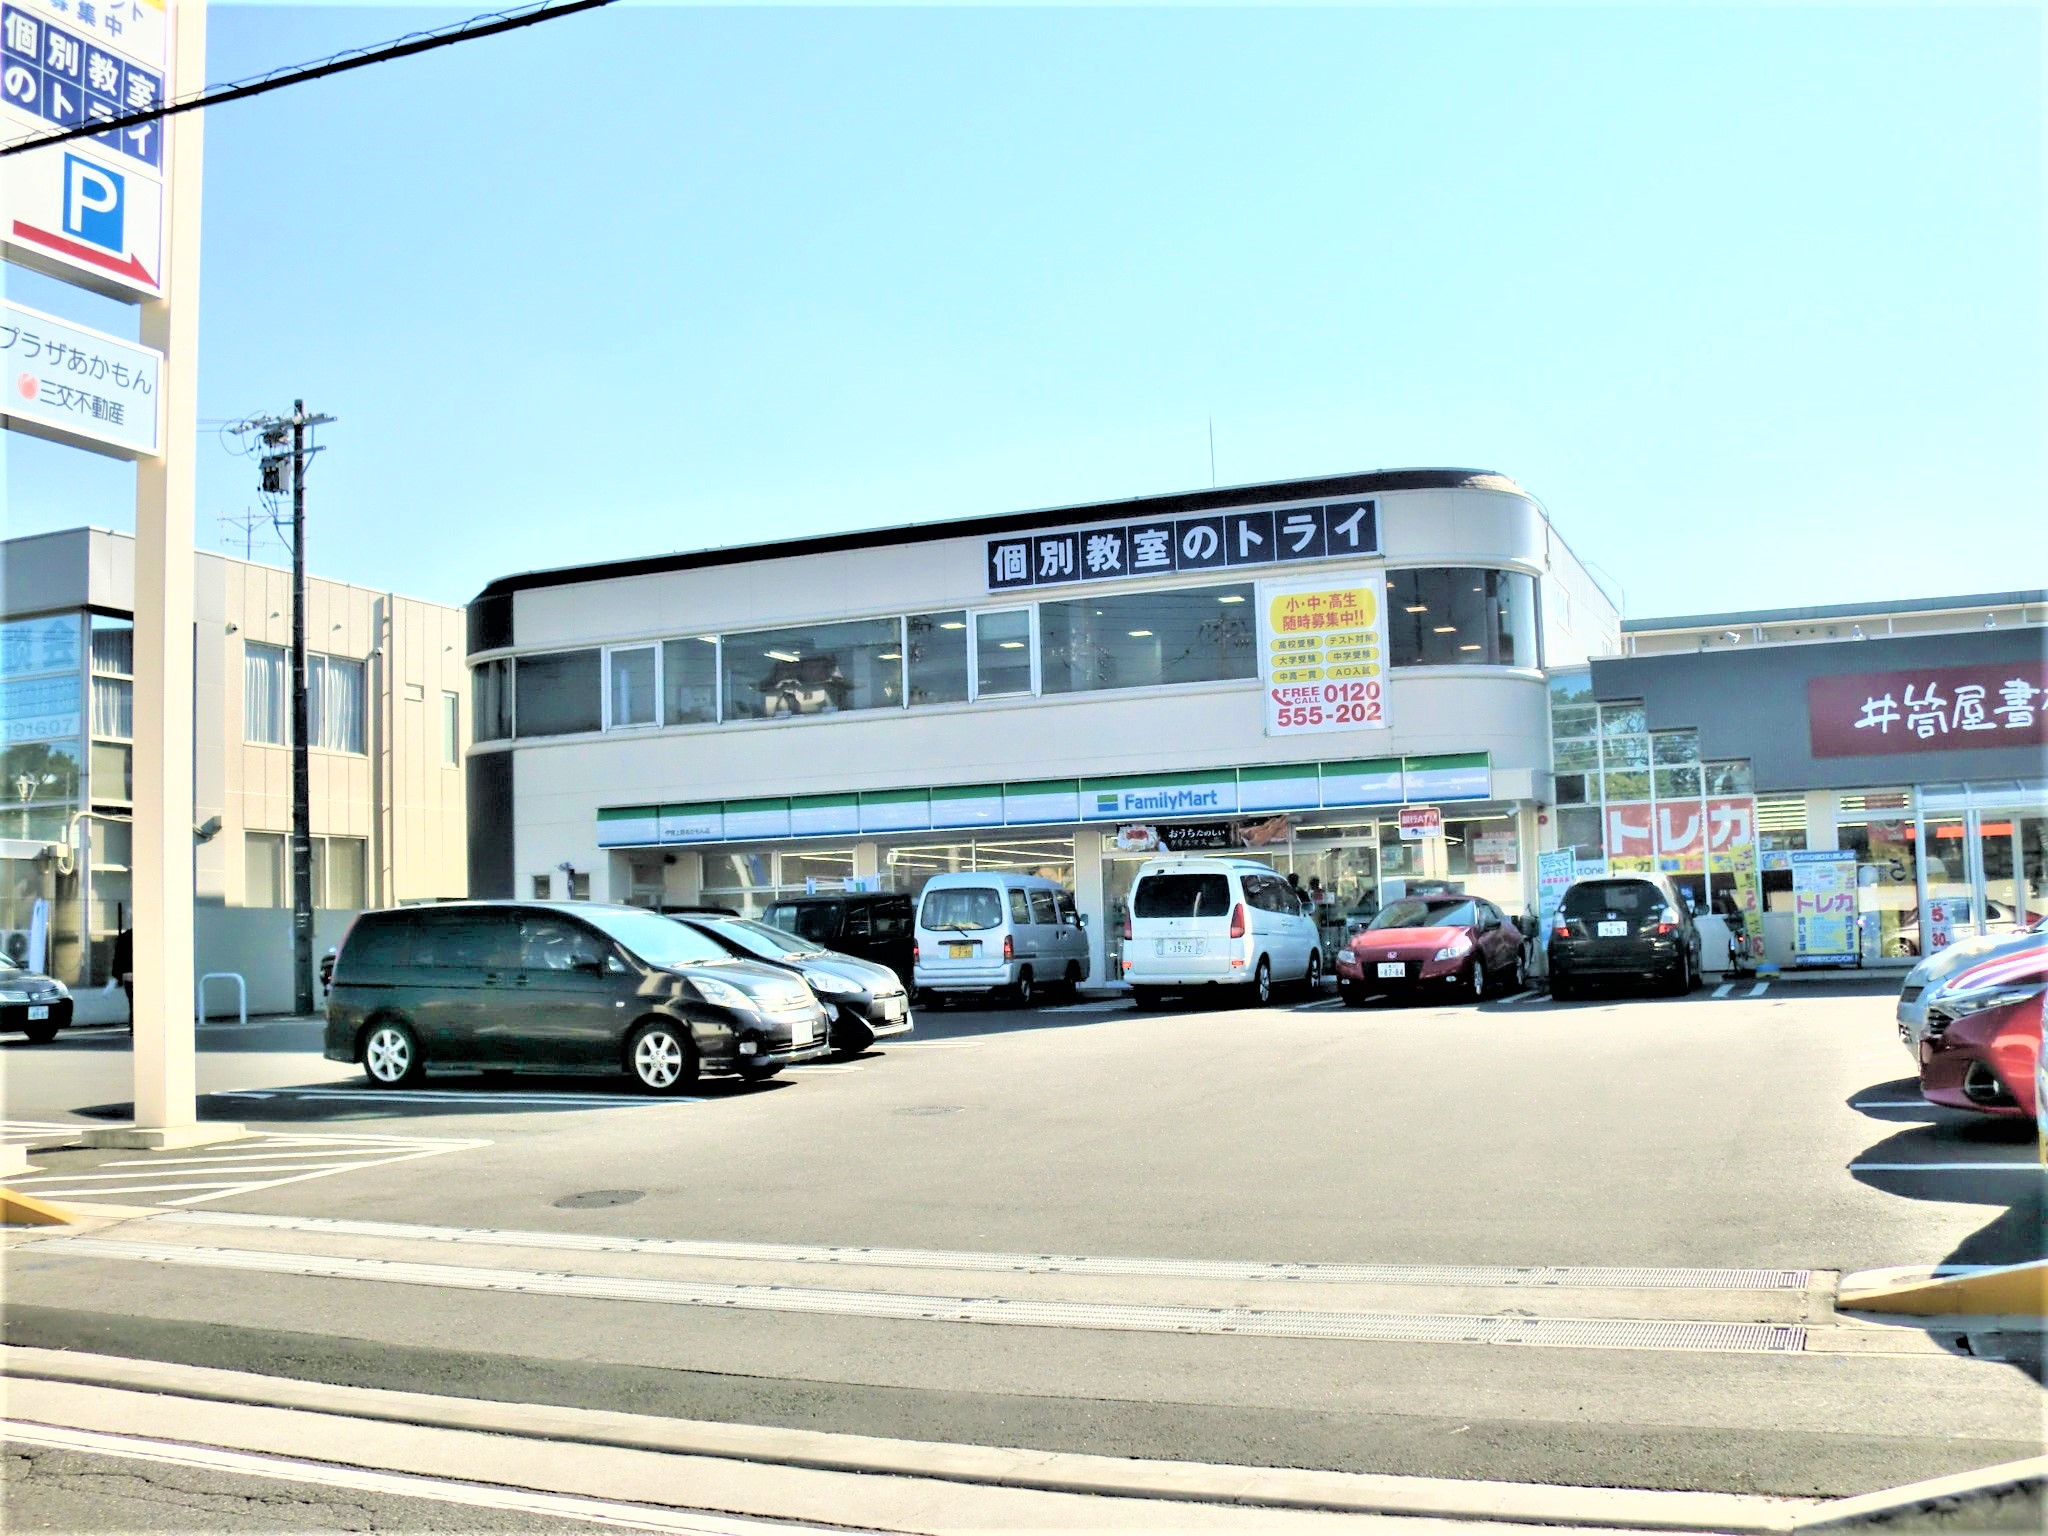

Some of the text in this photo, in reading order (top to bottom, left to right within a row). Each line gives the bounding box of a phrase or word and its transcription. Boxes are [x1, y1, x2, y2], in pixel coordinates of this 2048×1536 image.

[4, 12, 155, 114] 個別教室
[70, 160, 117, 232] P
[0, 325, 152, 395] プラザあかもん
[40, 379, 124, 425] 三交不動産
[993, 508, 1367, 581] 個別教室のトライ
[1286, 592, 1357, 612] 小・中・高生
[1278, 638, 1315, 649] 高校受験
[1279, 655, 1316, 665] 大学受験
[1333, 650, 1371, 660] 中学受験
[1280, 670, 1317, 681] 中高一貫
[1283, 686, 1320, 698] FREE
[1294, 696, 1320, 704] CALL
[1324, 681, 1380, 703] 0120
[1277, 702, 1381, 727] 555-202
[1854, 678, 2048, 739] 井筒屋書
[1125, 790, 1217, 810] FamilyMart
[1610, 804, 1750, 853] トレカ
[1796, 893, 1853, 913] トレカ
